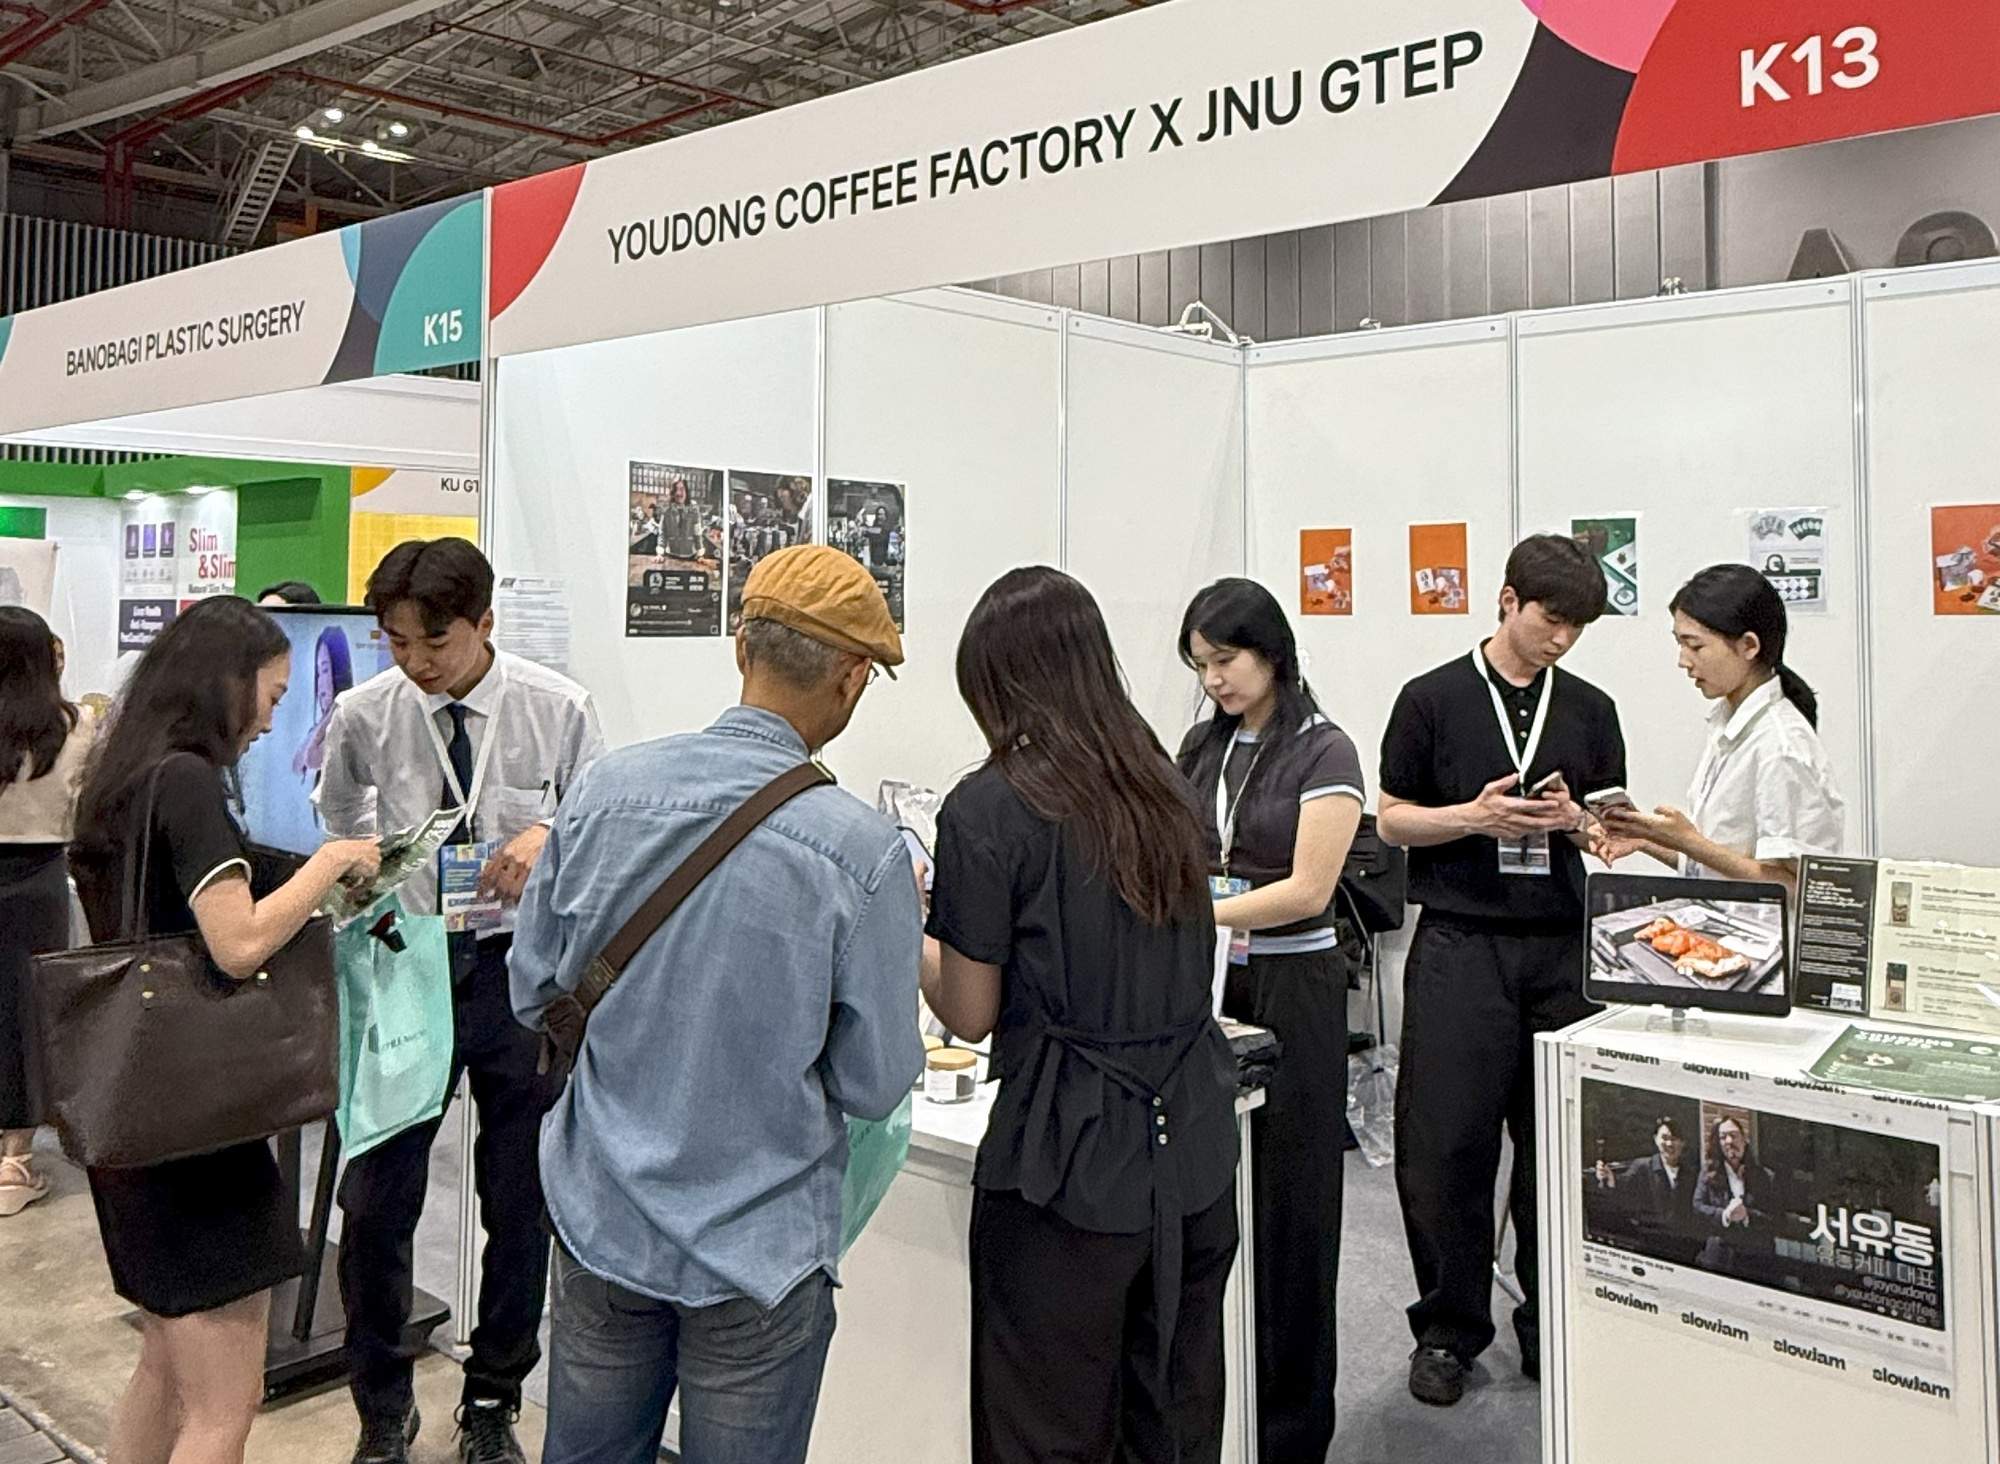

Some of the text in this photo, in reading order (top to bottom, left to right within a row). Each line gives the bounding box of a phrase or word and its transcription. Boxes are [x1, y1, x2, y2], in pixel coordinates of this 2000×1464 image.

[1740, 26, 1880, 108] K13
[607, 28, 1485, 265] YOUDONG COFFEE FACTORY X JNU GTEP
[66, 299, 306, 377] BANOBAGI PLASTIC SURGERY
[423, 309, 463, 347] K15
[440, 477, 461, 492] KU
[189, 527, 218, 553] Slim
[1808, 1203, 1935, 1267] 서유동
